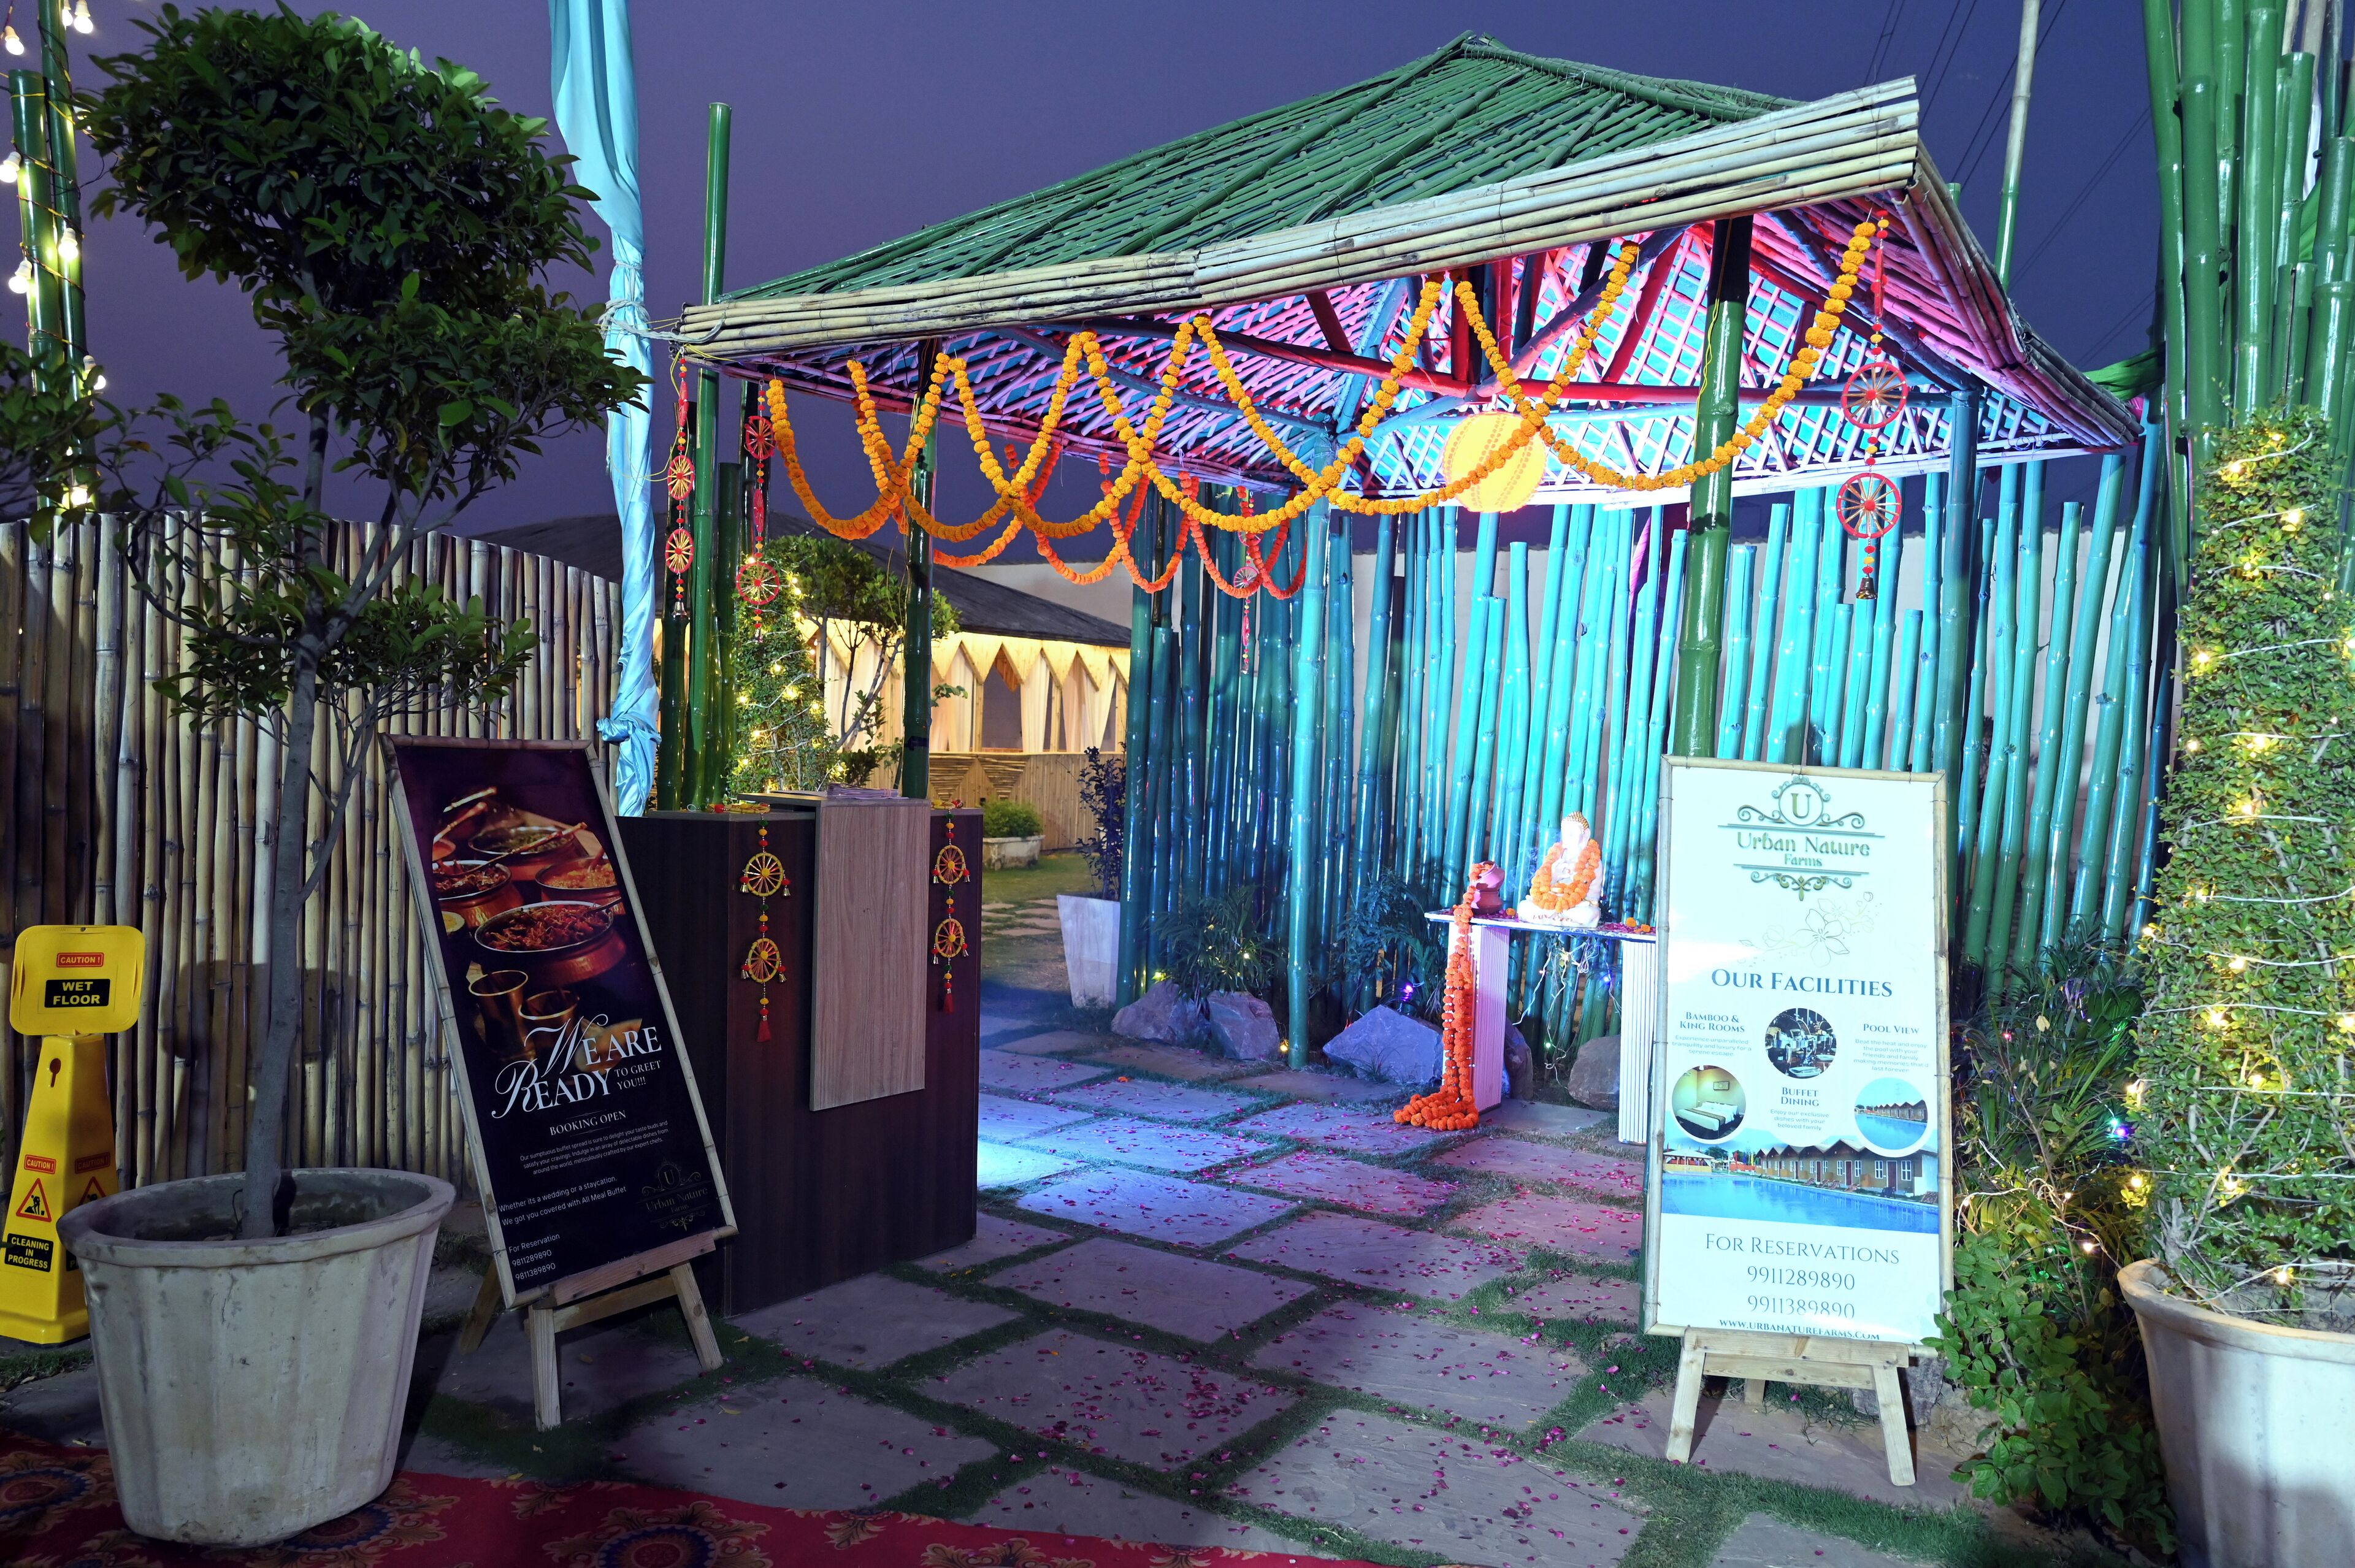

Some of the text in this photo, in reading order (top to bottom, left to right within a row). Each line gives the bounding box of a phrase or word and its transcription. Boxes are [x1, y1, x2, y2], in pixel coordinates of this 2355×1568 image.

[1791, 793, 1812, 819] U
[1737, 832, 1870, 856] Urban Nature
[1784, 853, 1823, 866] Farms
[62, 982, 93, 991] WET
[1711, 969, 1893, 997] OUR FACILITIES
[53, 995, 100, 1005] FLOOR
[1686, 1012, 1728, 1022] BAMBOO
[1680, 1021, 1745, 1033] KING ROOMS
[1863, 1023, 1920, 1034] POOL VIEW
[524, 1014, 662, 1077] WE ARE
[614, 1060, 661, 1078] TO GREET
[491, 1058, 613, 1119] READY
[616, 1076, 646, 1090] YOU!!!
[1782, 1087, 1819, 1097] BUFFET
[1781, 1096, 1819, 1107] DINING
[550, 1110, 627, 1136] BOOKING OPEN
[619, 1134, 642, 1145] delectable
[530, 1149, 556, 1159] sumptuous
[533, 1166, 550, 1174] around
[573, 1153, 603, 1165] meticulously
[499, 1200, 526, 1212] Whether
[542, 1189, 570, 1201] wedding
[515, 1215, 526, 1224] got
[526, 1211, 538, 1221] you
[540, 1203, 566, 1215] covered
[567, 1199, 581, 1208] with
[591, 1191, 607, 1201] Meal
[607, 1186, 627, 1196] Buffet
[646, 1188, 708, 1212] Urban Nature
[11, 1236, 49, 1250] CLEANING
[521, 1234, 560, 1250] Reservation
[1706, 1233, 1899, 1264] FOR RESERVATIONS
[8, 1254, 48, 1269] PROGRESS
[26, 1248, 33, 1257] IN
[512, 1249, 552, 1267] 9811289890
[515, 1263, 556, 1281] 9811389890
[1747, 1266, 1855, 1290] 9911289890
[1748, 1295, 1855, 1319] 9911389890
